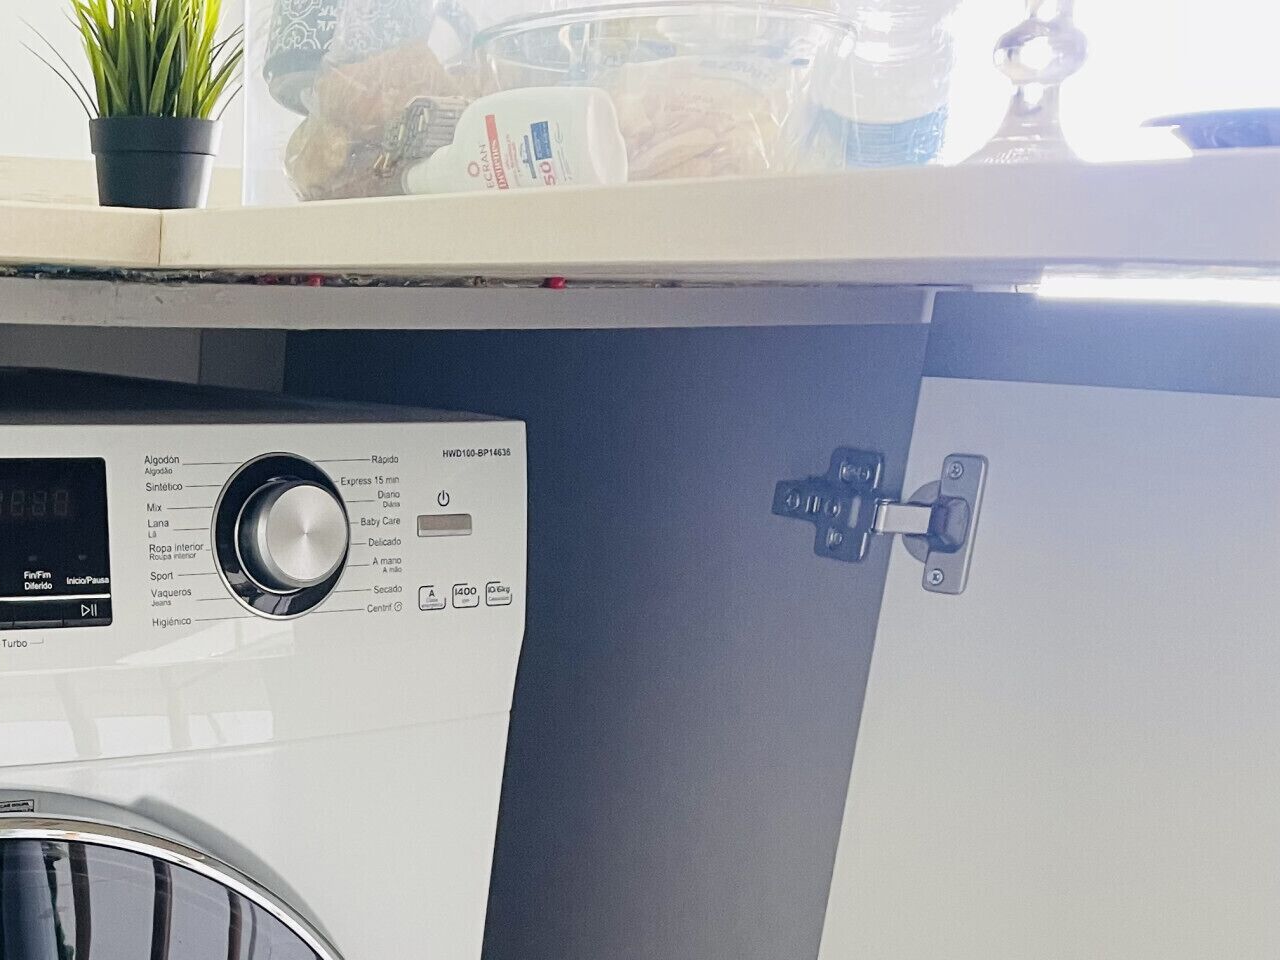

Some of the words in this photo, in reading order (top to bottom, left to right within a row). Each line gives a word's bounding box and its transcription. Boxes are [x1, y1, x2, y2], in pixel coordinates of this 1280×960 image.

[479, 144, 494, 188] ECRAN
[539, 161, 556, 186] 50
[144, 455, 180, 466] Algodón
[340, 477, 372, 487] Express
[375, 476, 384, 484] 15
[145, 482, 183, 492] Sintético
[146, 503, 162, 512] Mix
[147, 519, 169, 528] Lana
[360, 517, 380, 527] Baby
[382, 516, 401, 525] Care
[368, 537, 402, 547] Delicado
[149, 544, 172, 554] Ropa
[174, 543, 204, 552] interior
[149, 553, 172, 561] Roupa
[372, 557, 379, 566] A
[23, 570, 52, 580] Fin/Fim
[150, 571, 174, 582] Sport
[24, 581, 53, 591] Diferido
[373, 585, 403, 594] Secado
[150, 588, 192, 598] Vaqueros
[428, 589, 436, 598] A
[455, 587, 477, 596] 1400
[1, 639, 28, 648] Turbo
